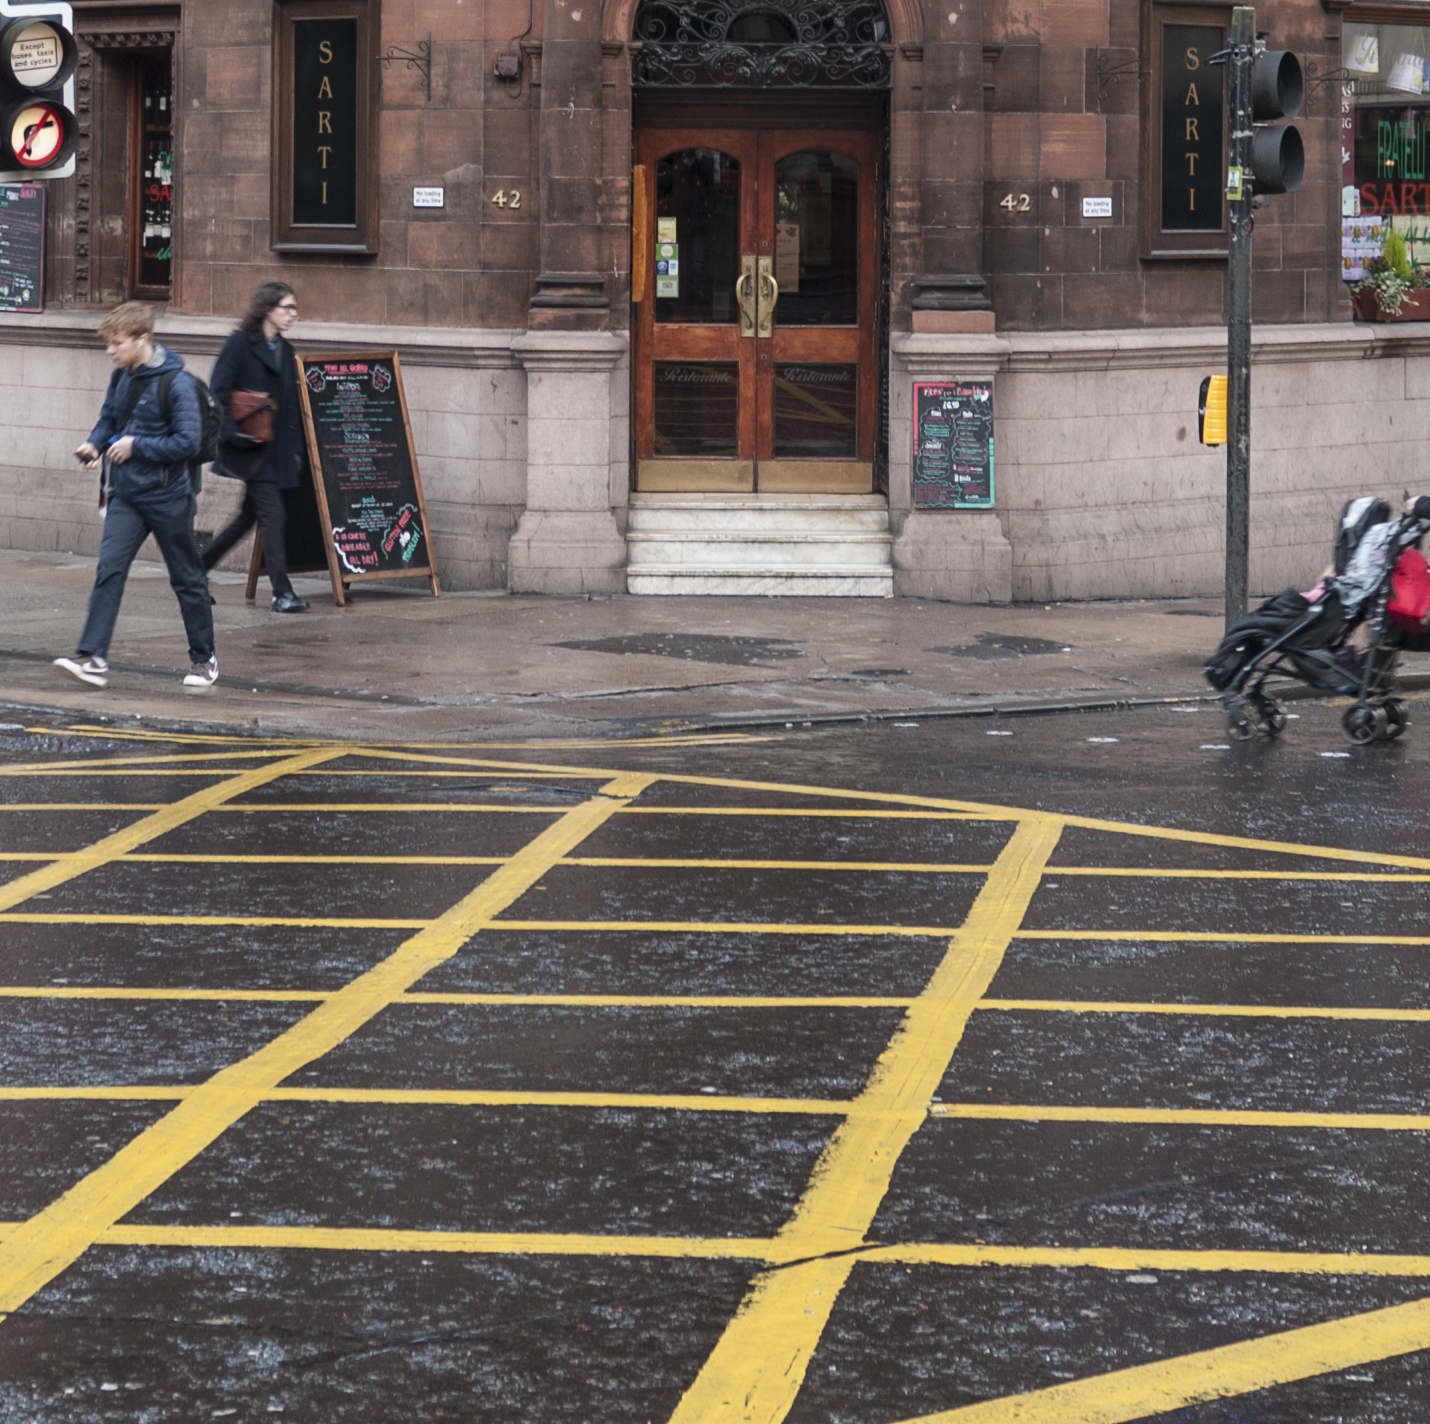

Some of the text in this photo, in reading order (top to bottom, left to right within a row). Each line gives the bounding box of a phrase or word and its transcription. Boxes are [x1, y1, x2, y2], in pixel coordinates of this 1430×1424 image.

[317, 41, 333, 205] SARTI
[1184, 47, 1201, 211] SARTI
[1377, 119, 1426, 180] FRATELLI
[491, 189, 521, 209] 42
[1000, 193, 1031, 212] 42
[660, 367, 733, 384] Ristorante
[783, 366, 852, 383] Ristorante
